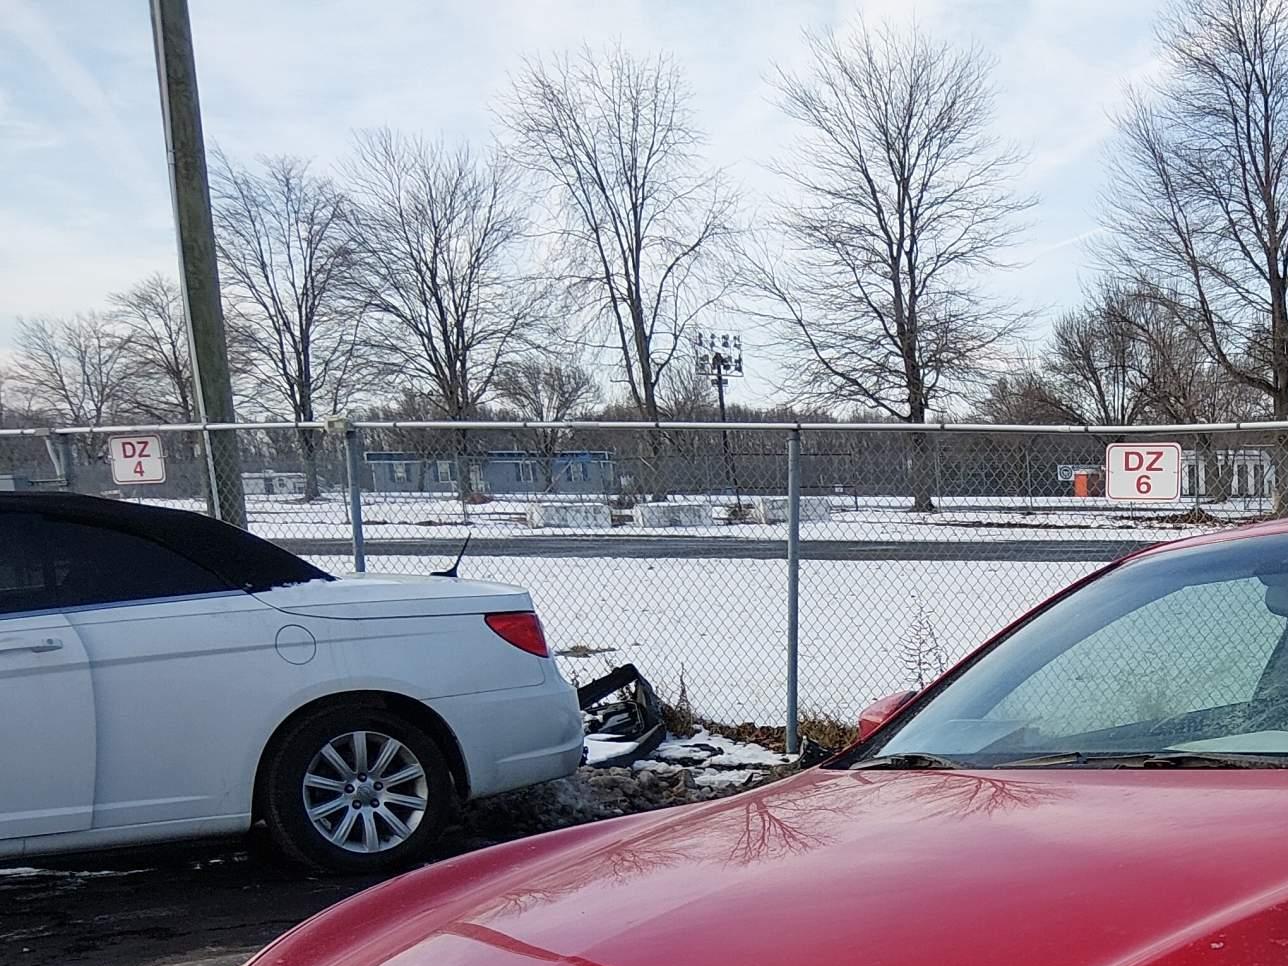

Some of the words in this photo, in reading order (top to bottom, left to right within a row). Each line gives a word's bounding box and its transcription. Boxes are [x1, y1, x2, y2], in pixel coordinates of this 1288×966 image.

[121, 440, 151, 459] DZ
[133, 460, 145, 477] 4
[1124, 451, 1164, 472] DZ
[1136, 474, 1152, 495] 6
